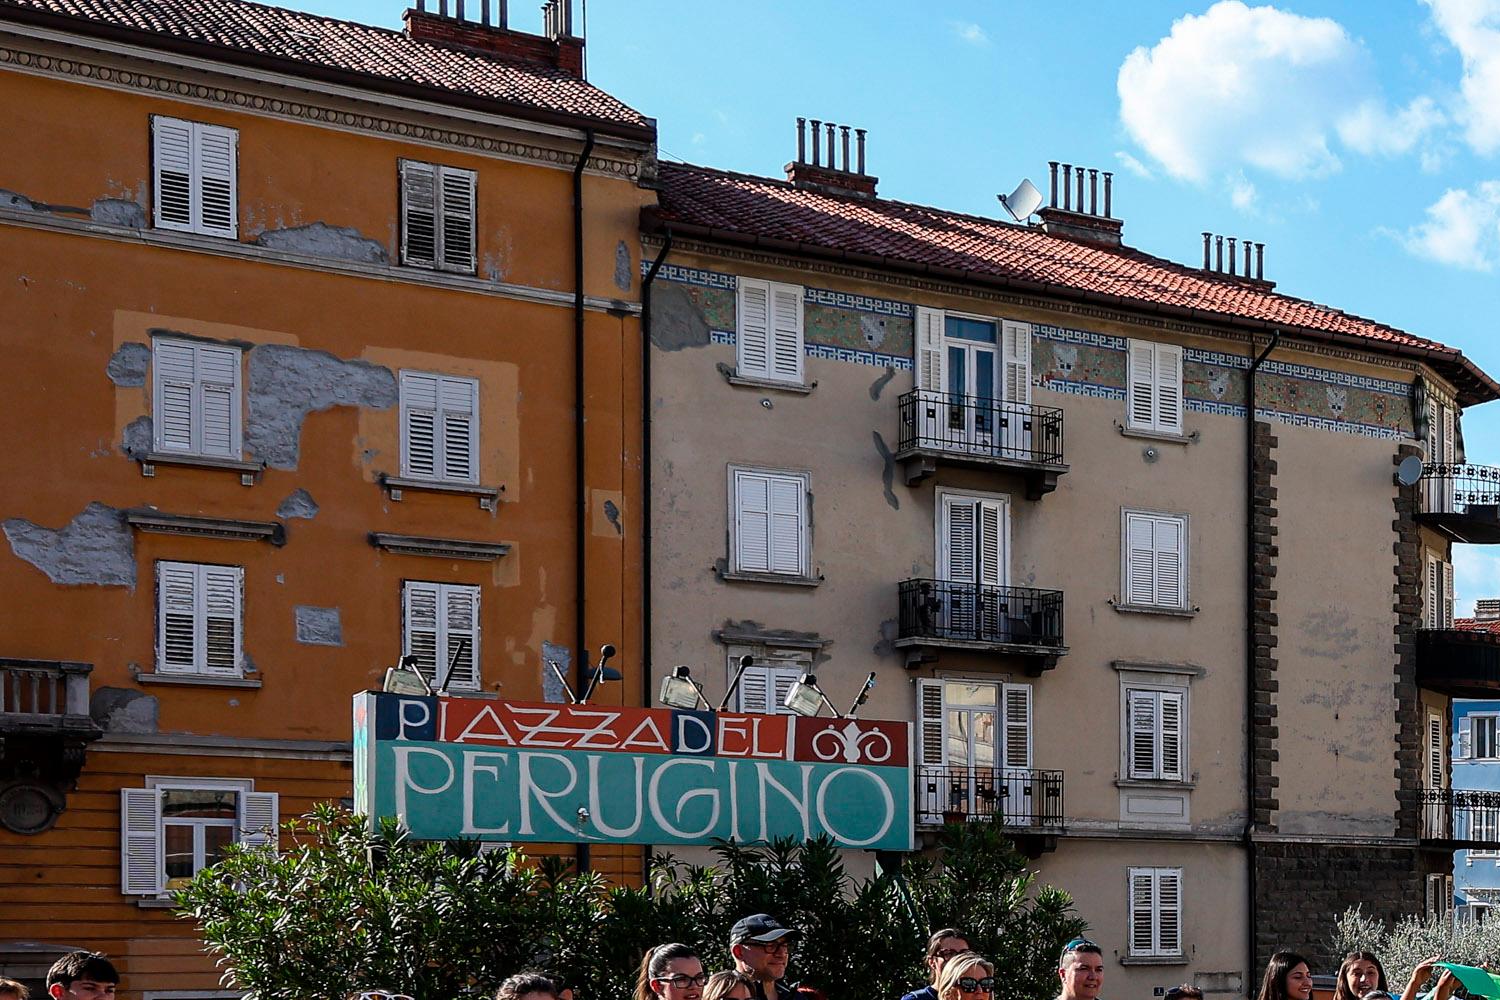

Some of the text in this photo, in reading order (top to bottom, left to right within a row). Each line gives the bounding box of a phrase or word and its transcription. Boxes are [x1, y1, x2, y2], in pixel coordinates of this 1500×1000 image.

[395, 698, 783, 757] PIAZZA DEL
[391, 746, 895, 846] PERUGINO
